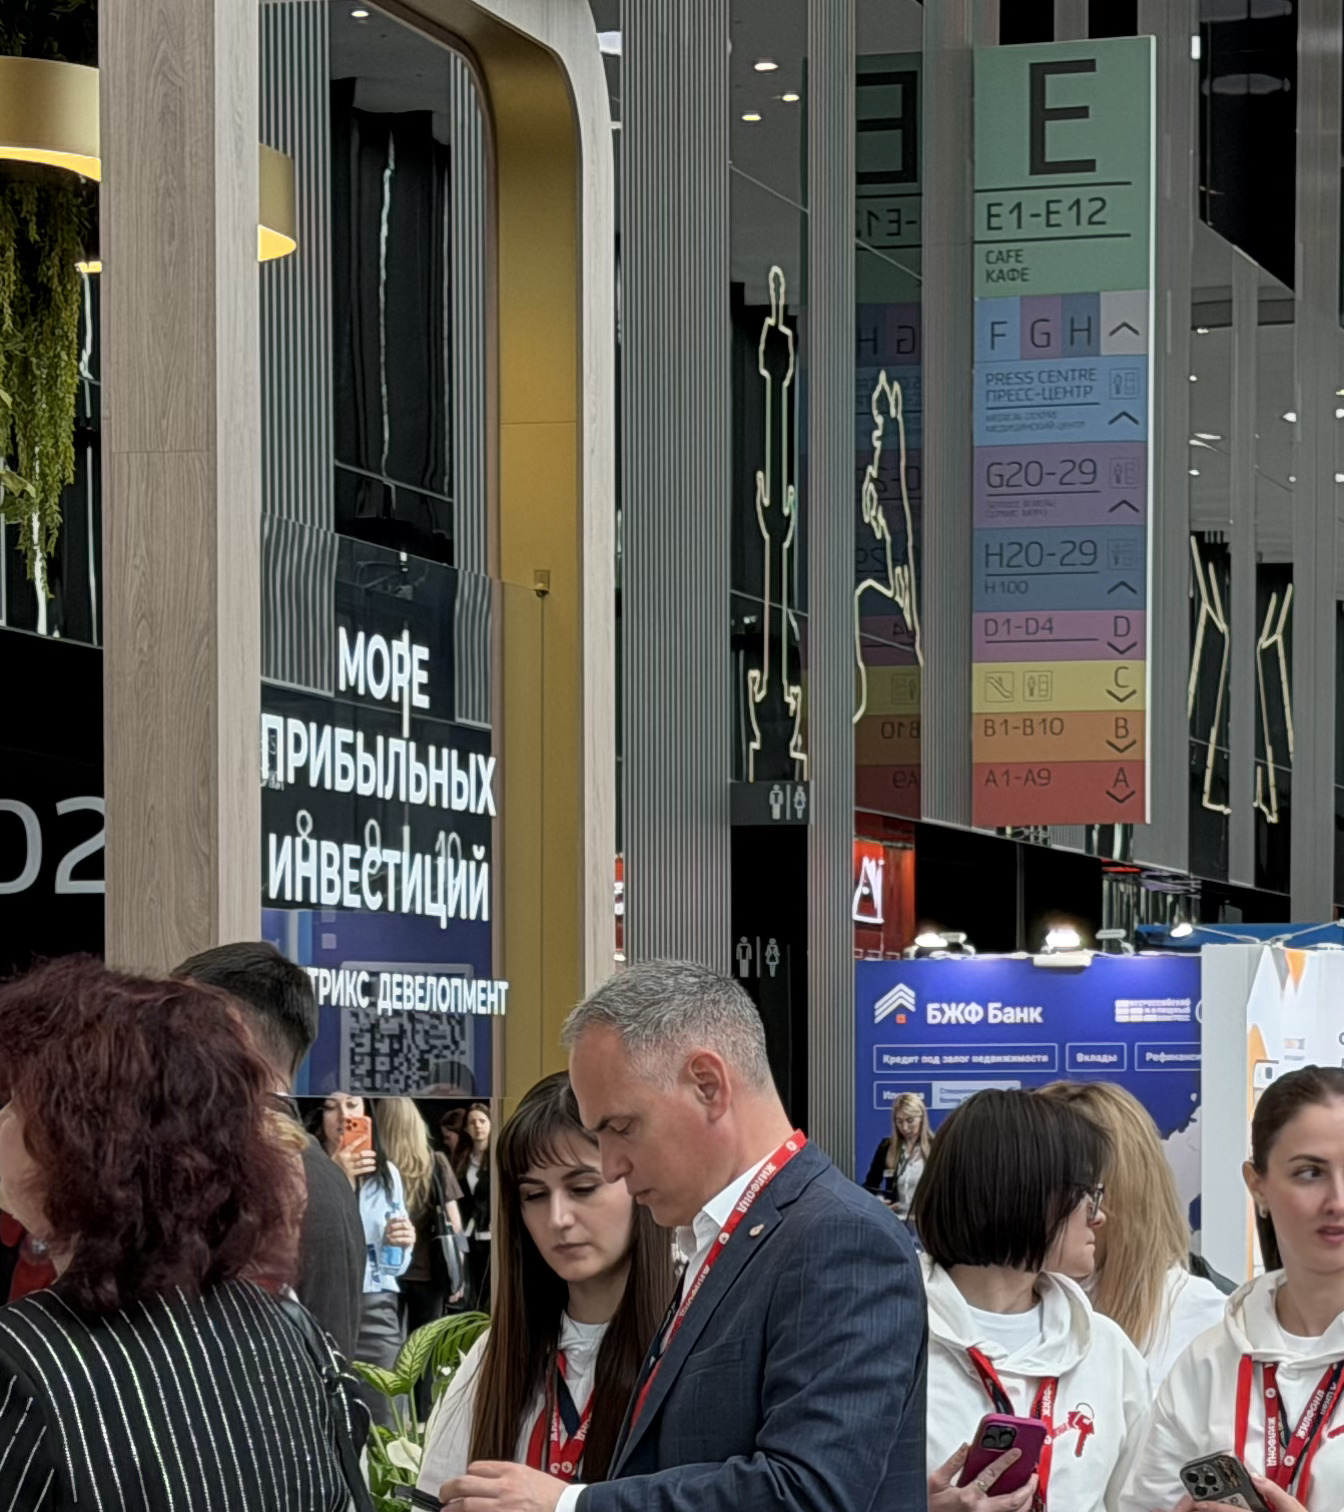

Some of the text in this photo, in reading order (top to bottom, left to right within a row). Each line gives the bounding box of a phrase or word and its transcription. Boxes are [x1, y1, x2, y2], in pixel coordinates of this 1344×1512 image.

[1029, 59, 1096, 176] E
[986, 197, 1107, 231] E1-E12
[985, 249, 1023, 265] CAFE
[985, 267, 1030, 284] КАФЕ
[990, 316, 1092, 350] F G H
[985, 368, 1098, 386] PRESS CENTRE
[985, 385, 1093, 402] ПРЕСС-ЦЕНТР
[986, 458, 1098, 489] G20-29
[985, 540, 1098, 569] H20-29
[984, 615, 1131, 637] D1-D4 D
[338, 626, 430, 708] МОРЕ
[1114, 666, 1129, 688] C
[984, 717, 1129, 739] B1-B10 B
[261, 713, 497, 817] ПРИБЫЛЬНЫХ
[984, 767, 1129, 788] A1-A9 A
[268, 832, 490, 930] ИНВЕСТИЦИЙ
[305, 966, 509, 1016] ТРИКС ДЕВЕЛОПМЕНТ
[926, 1002, 1043, 1025] БЖФ Банк
[883, 1054, 919, 1066] Кредит
